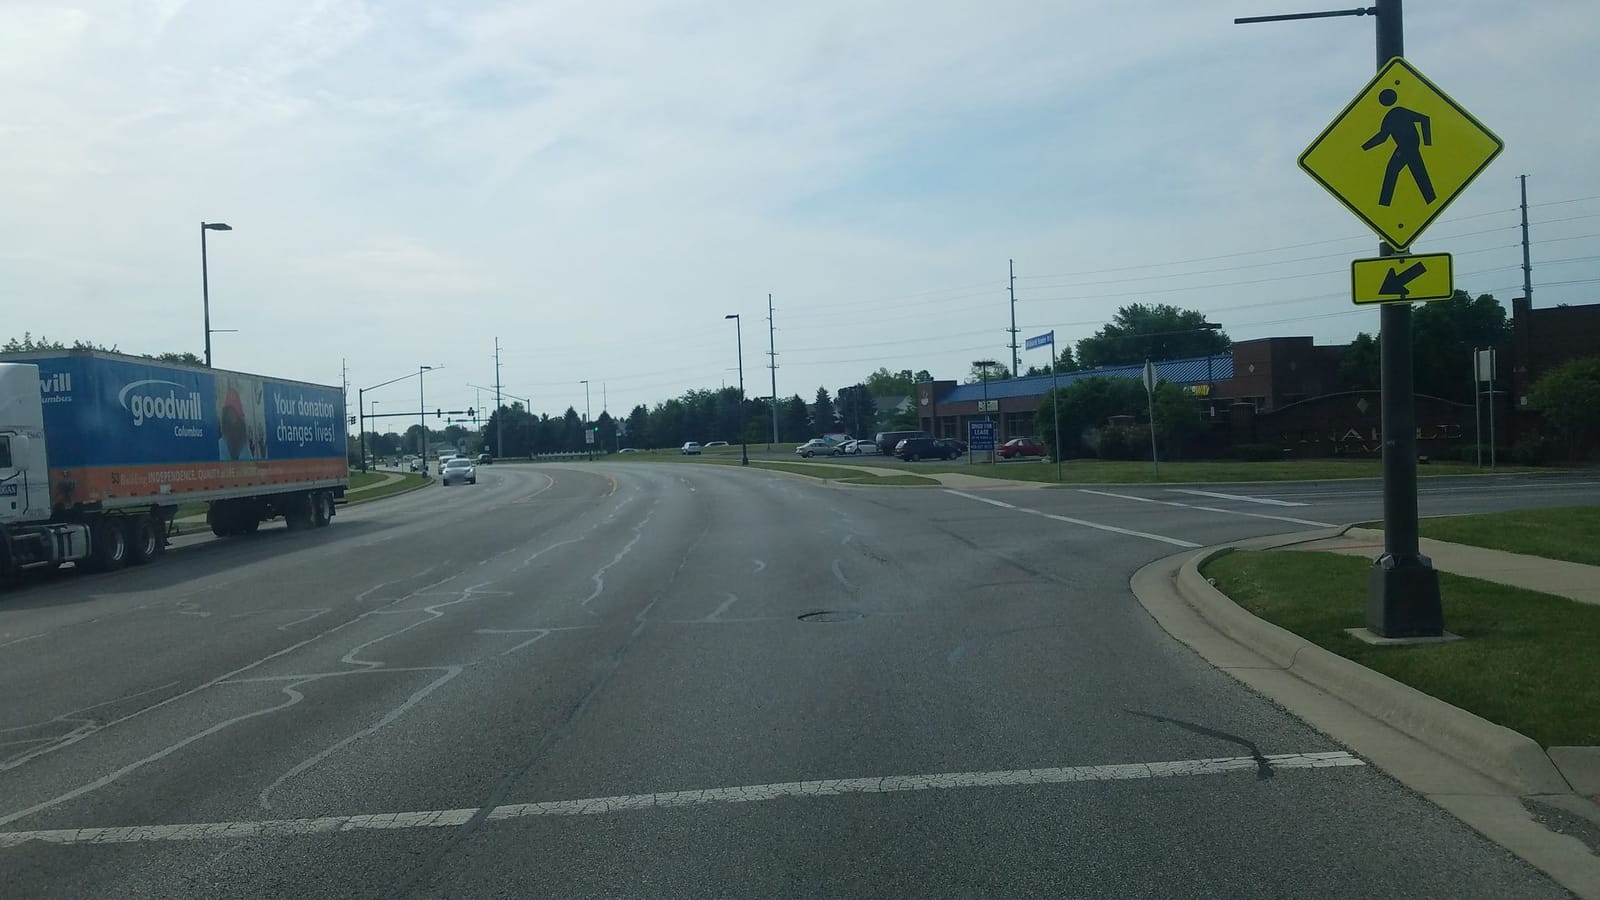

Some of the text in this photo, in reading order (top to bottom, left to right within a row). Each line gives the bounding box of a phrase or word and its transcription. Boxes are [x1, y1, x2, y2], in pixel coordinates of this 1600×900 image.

[131, 389, 202, 426] goodwill
[273, 392, 335, 418] Your donation
[174, 424, 203, 437] Columbus
[276, 418, 336, 447] changes lives!
